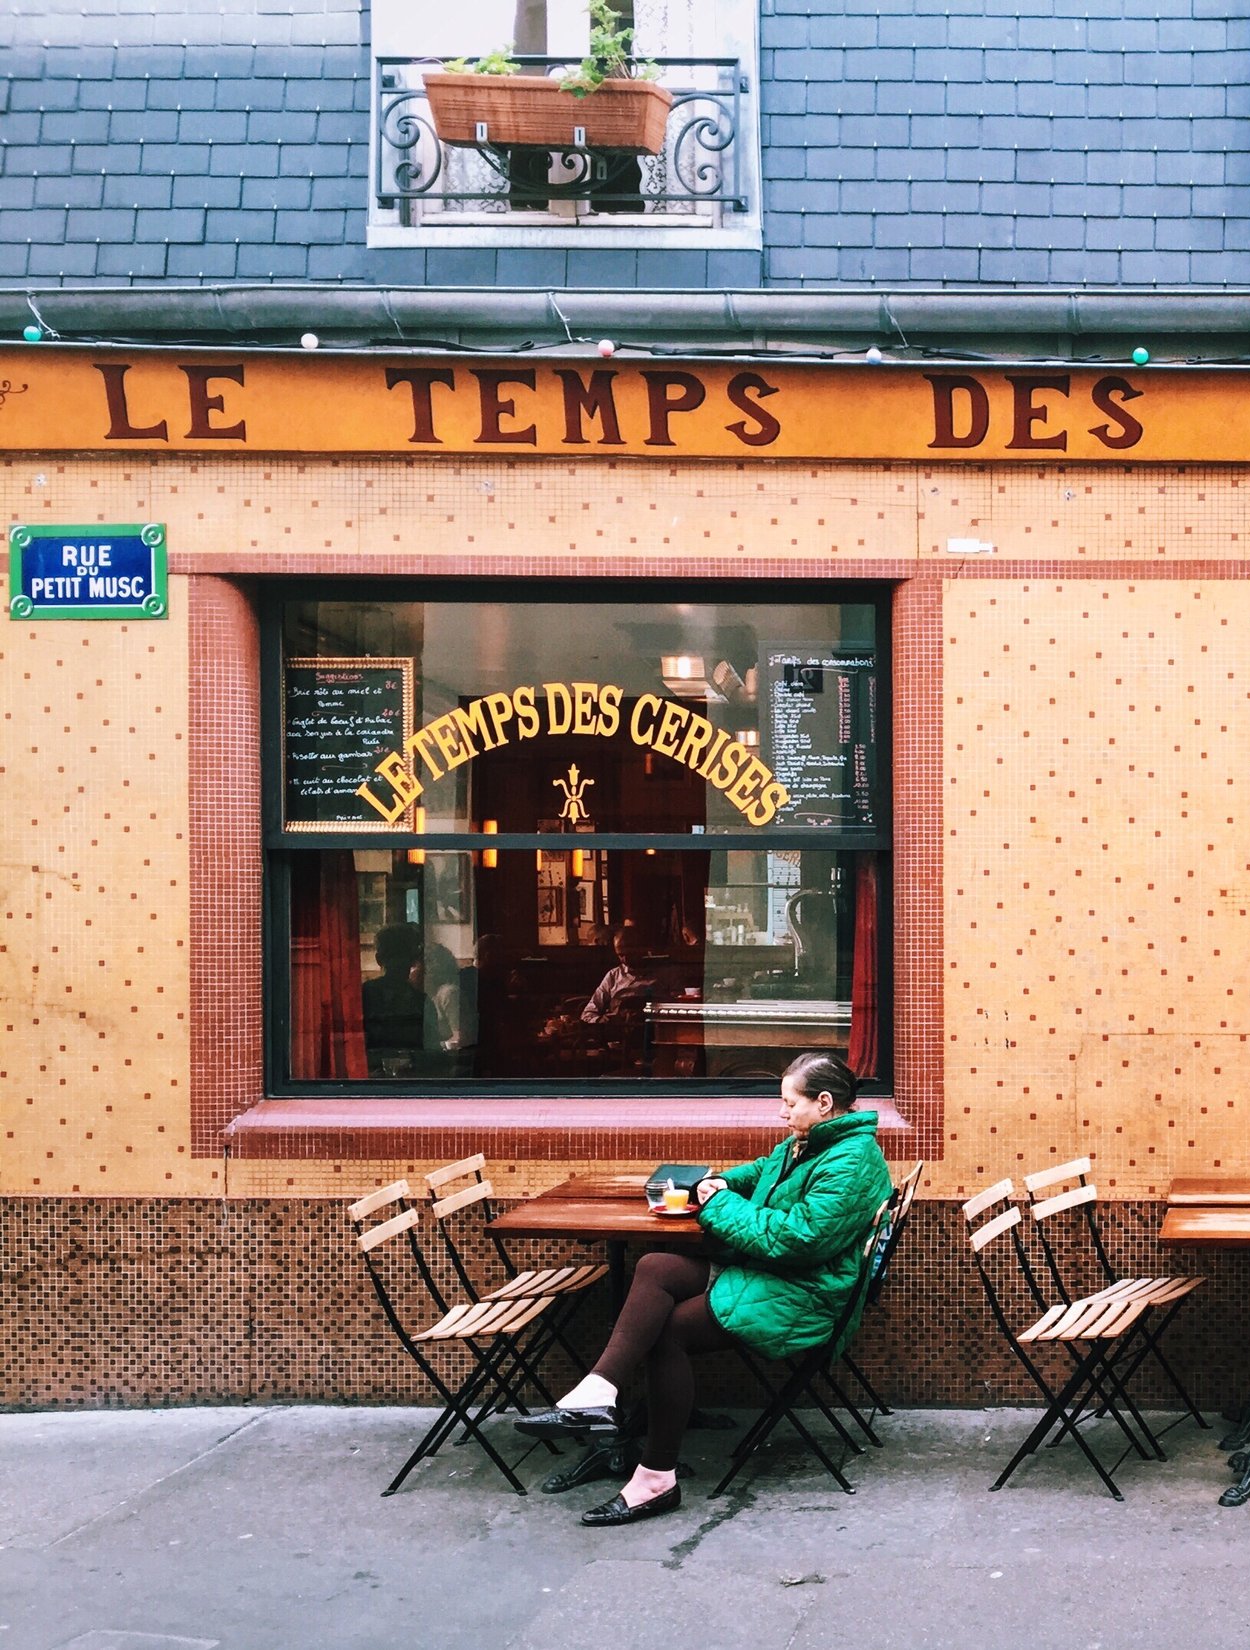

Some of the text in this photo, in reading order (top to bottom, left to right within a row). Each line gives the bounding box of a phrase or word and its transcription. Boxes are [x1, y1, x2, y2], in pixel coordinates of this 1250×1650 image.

[92, 363, 246, 443] LE
[385, 366, 782, 447] TEMPS
[923, 374, 1145, 453] DES
[62, 545, 112, 567] RUE
[76, 566, 99, 576] DU
[31, 576, 145, 599] PETIT MUSC
[356, 752, 424, 824] LE
[404, 685, 540, 781] TEMPS
[543, 682, 624, 737] DES
[631, 693, 790, 826] CERISES
